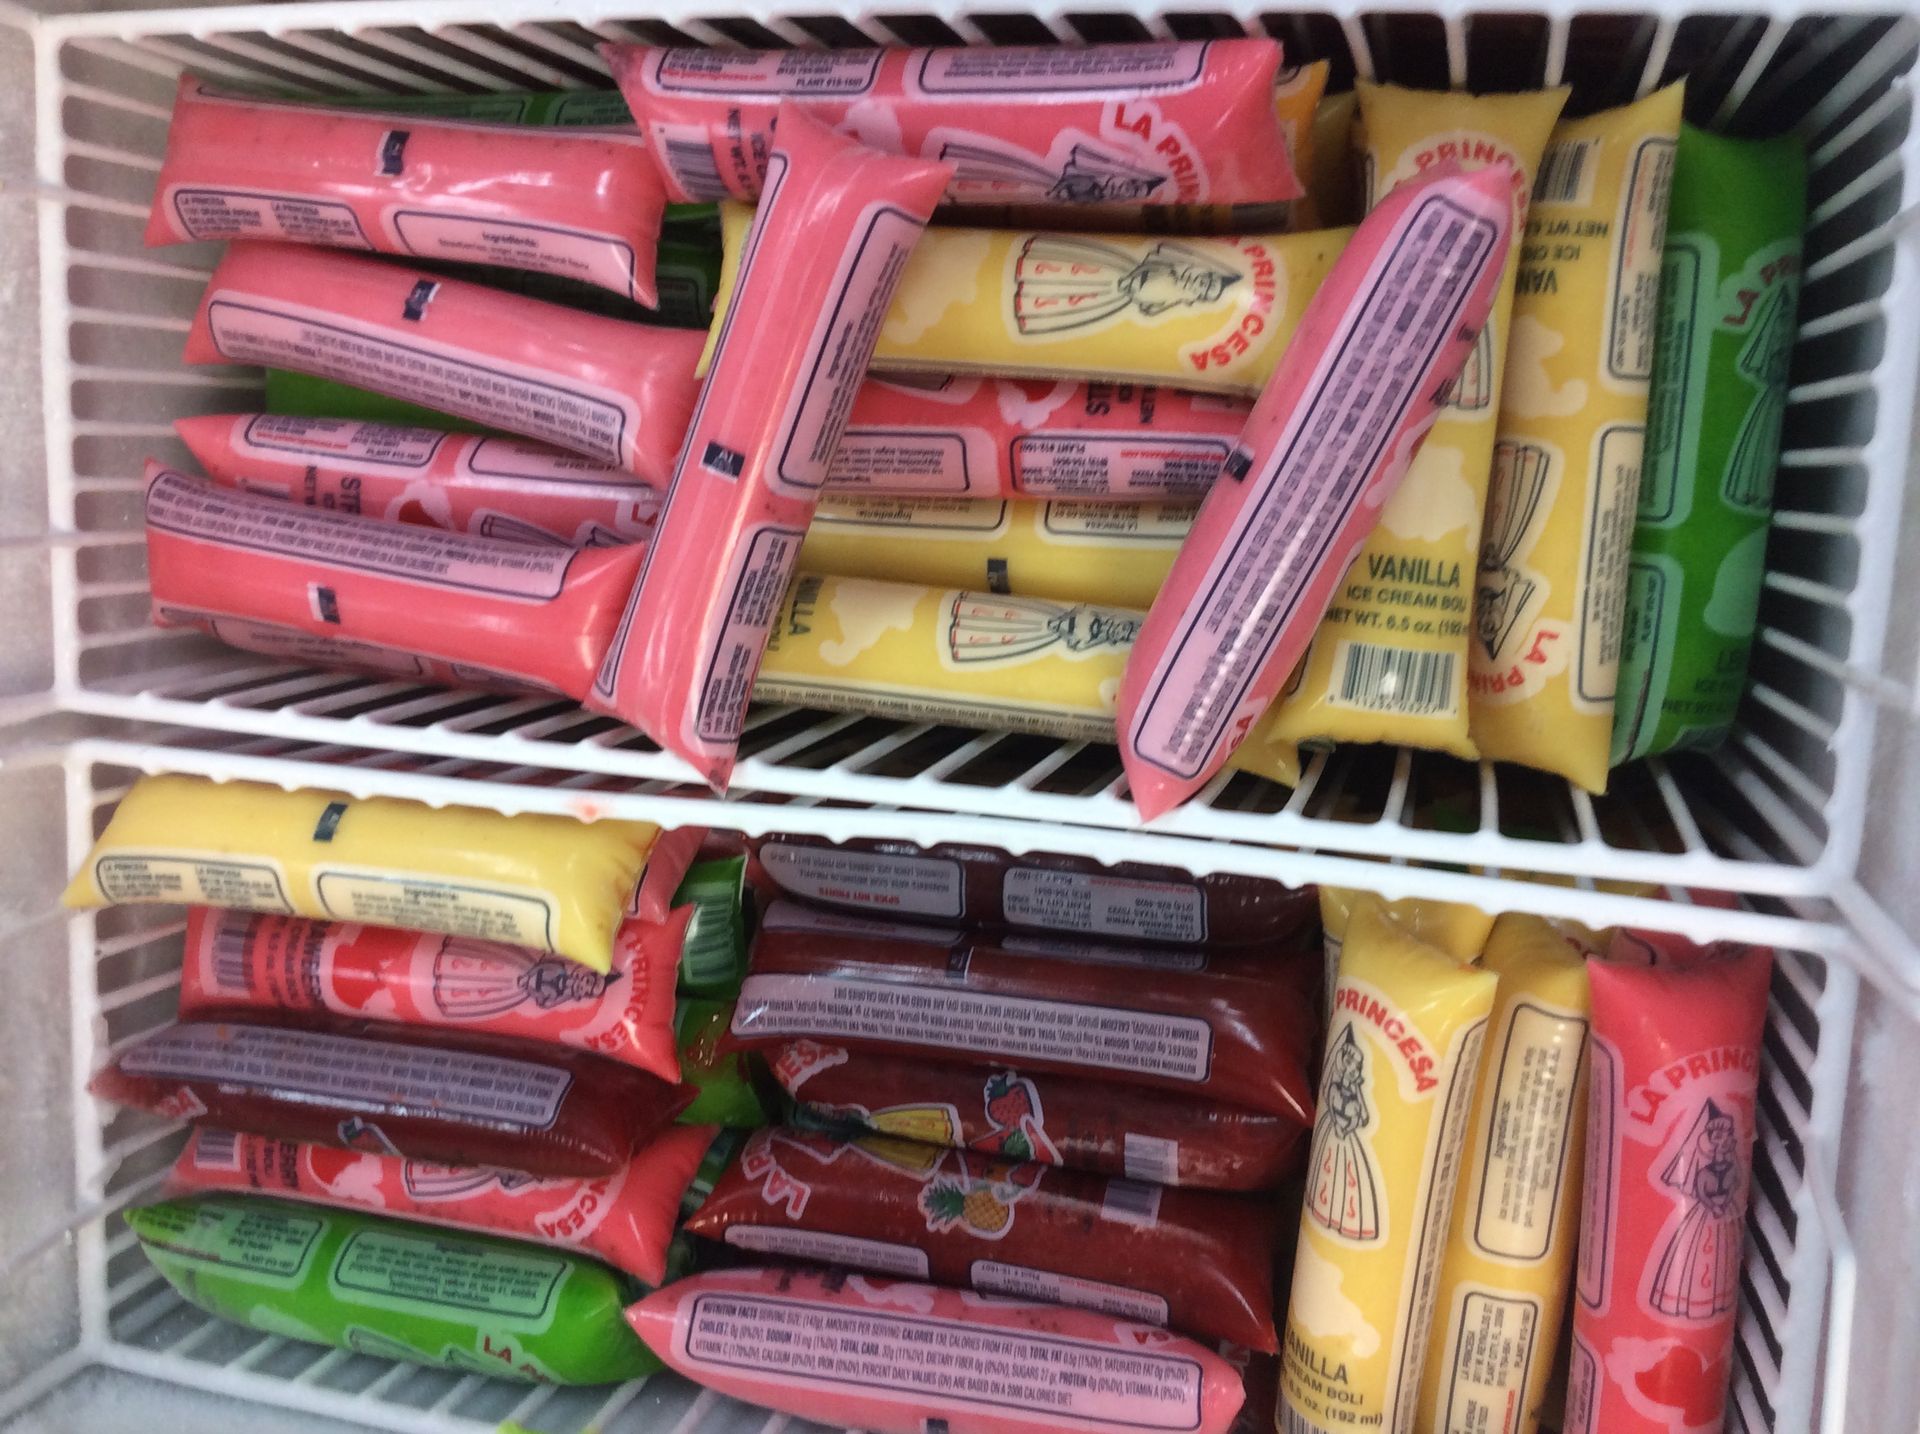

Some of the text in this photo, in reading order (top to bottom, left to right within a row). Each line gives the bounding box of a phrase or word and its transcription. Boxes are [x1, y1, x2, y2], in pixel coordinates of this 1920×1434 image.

[1114, 103, 1152, 143] LA
[1188, 242, 1276, 371] PRINCESA
[1368, 552, 1461, 588] VANILLA
[1346, 584, 1373, 601] ICE
[1376, 587, 1439, 610] CREAM
[1524, 630, 1561, 666] LA
[1335, 988, 1440, 1095] PRINCESA
[1630, 1088, 1669, 1126] LA
[1286, 1330, 1349, 1385] ANILLA
[1326, 1386, 1364, 1406] BOLI
[1359, 1411, 1384, 1426] ml)
